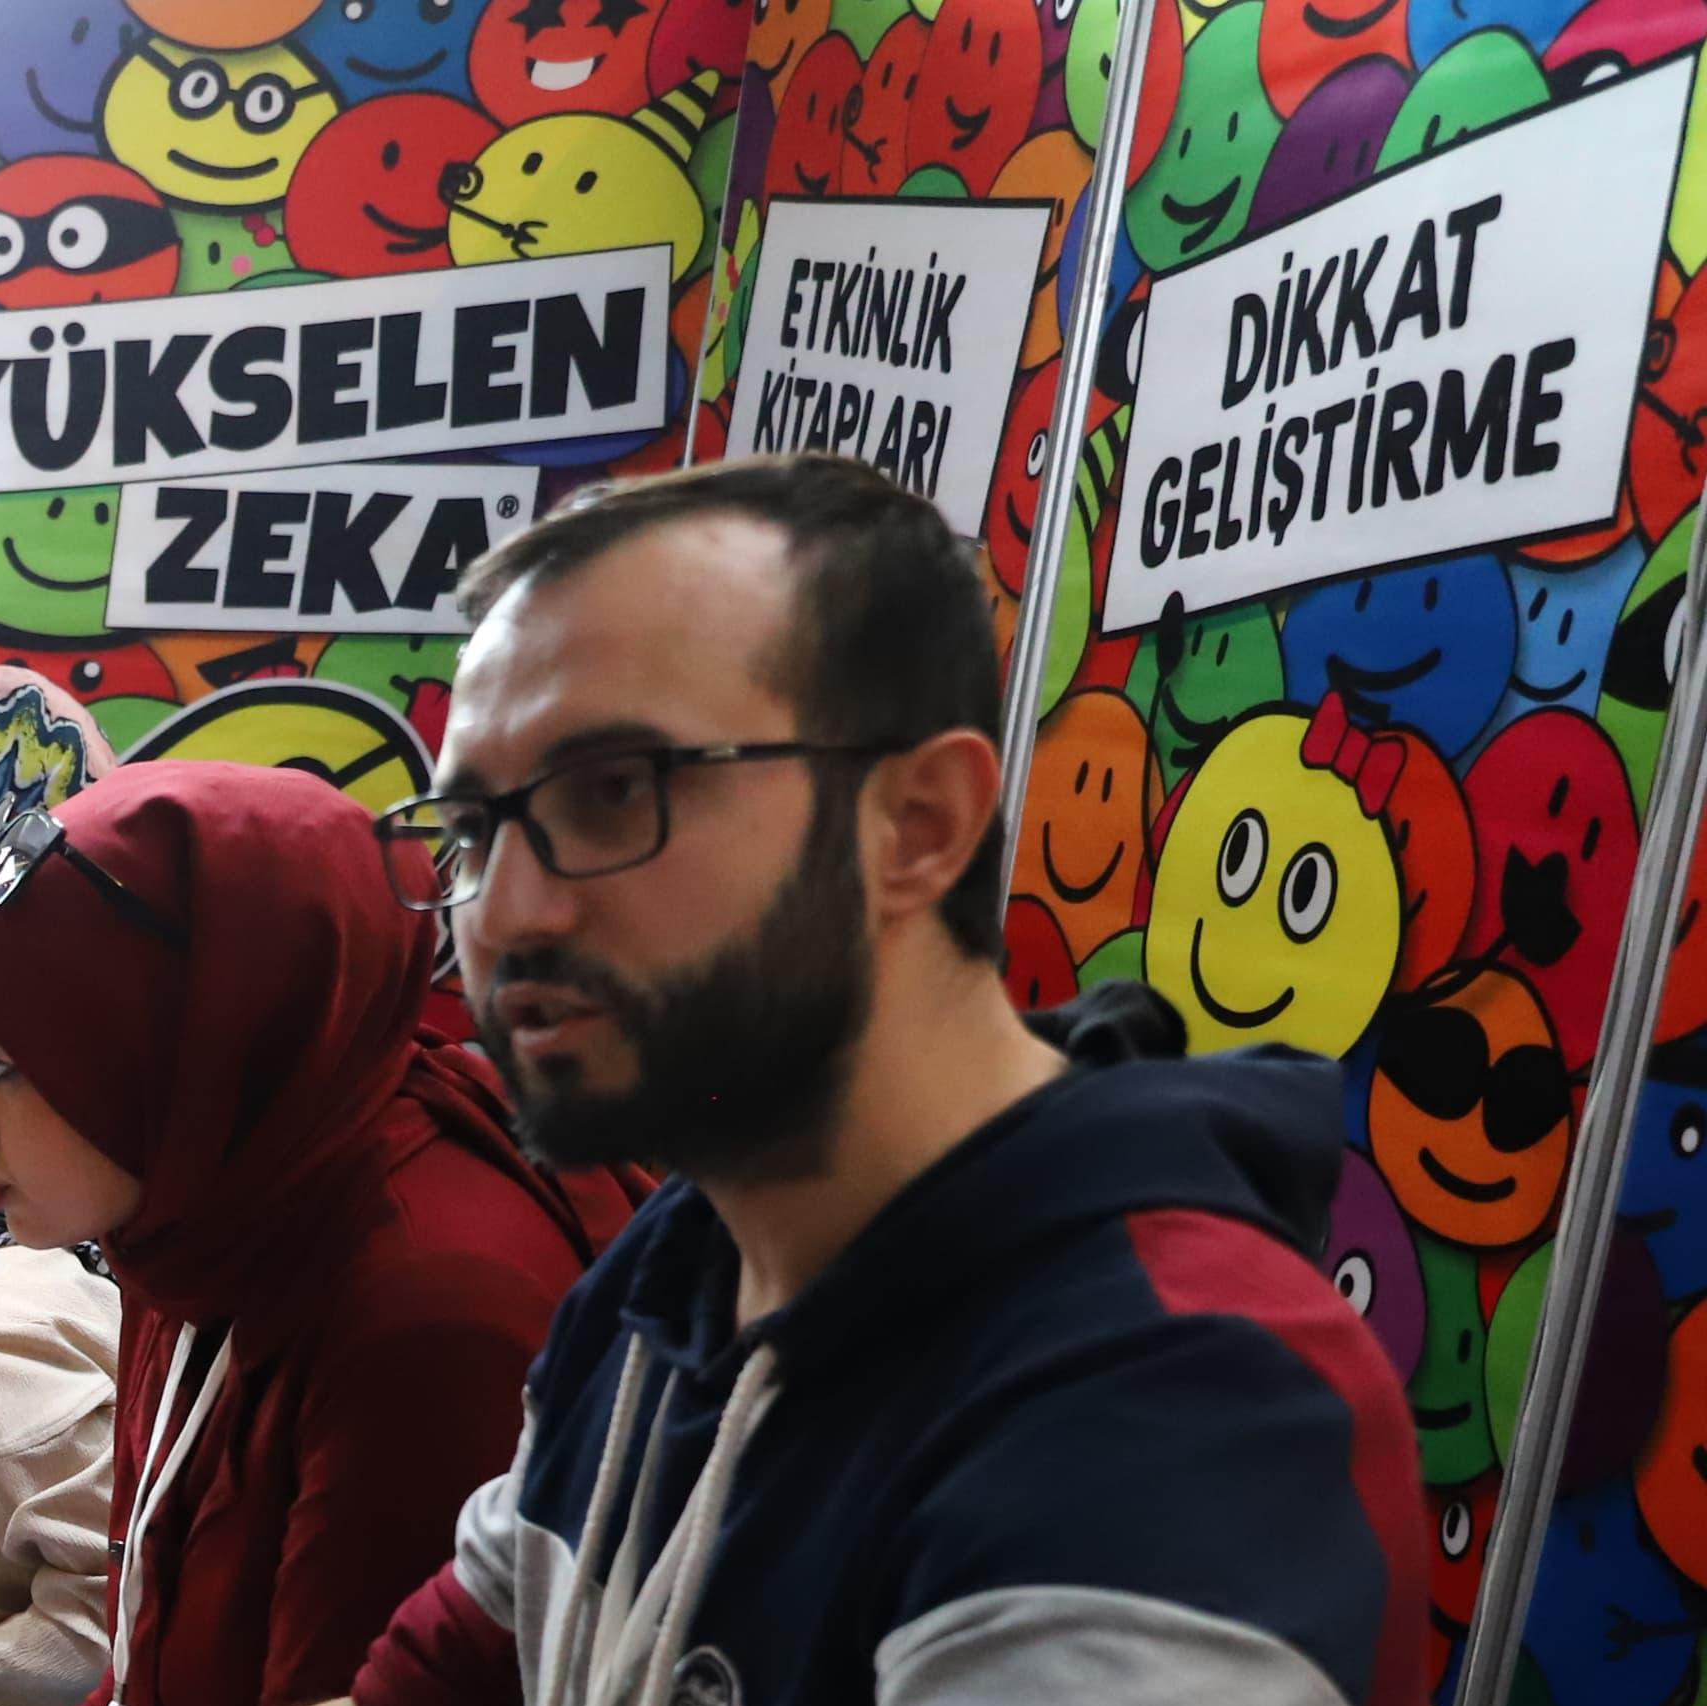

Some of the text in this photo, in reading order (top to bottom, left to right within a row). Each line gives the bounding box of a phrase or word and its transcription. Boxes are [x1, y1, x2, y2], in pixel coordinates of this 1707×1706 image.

[780, 246, 968, 375] ETKİNLİK
[1222, 194, 1501, 411] DİKKAT
[1140, 338, 1576, 569] GELİŞTİRME
[144, 486, 492, 617] ZEKA
